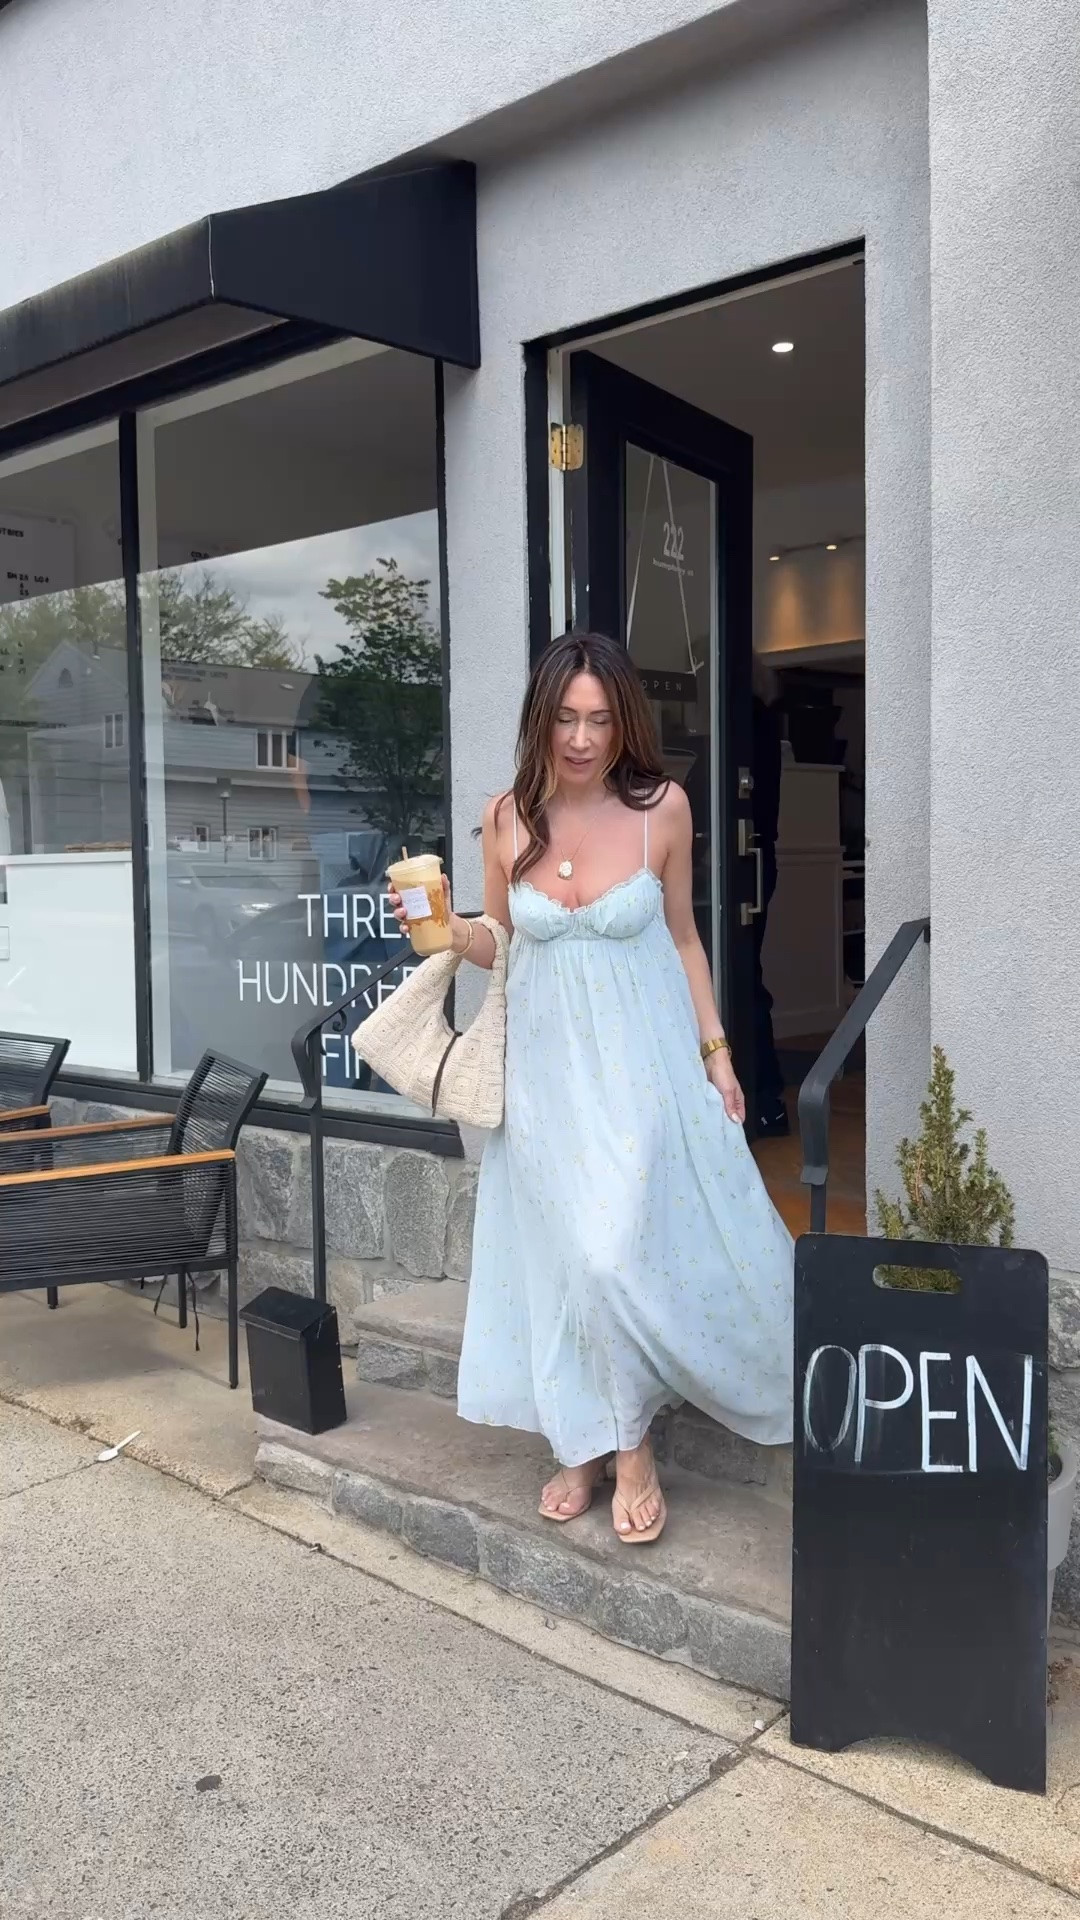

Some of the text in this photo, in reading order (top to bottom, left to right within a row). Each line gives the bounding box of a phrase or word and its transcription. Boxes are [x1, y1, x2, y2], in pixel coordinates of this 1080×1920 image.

[663, 521, 684, 561] 222
[641, 680, 682, 691] OPEN
[297, 893, 411, 939] THRE
[803, 1343, 1033, 1473] OPEN
